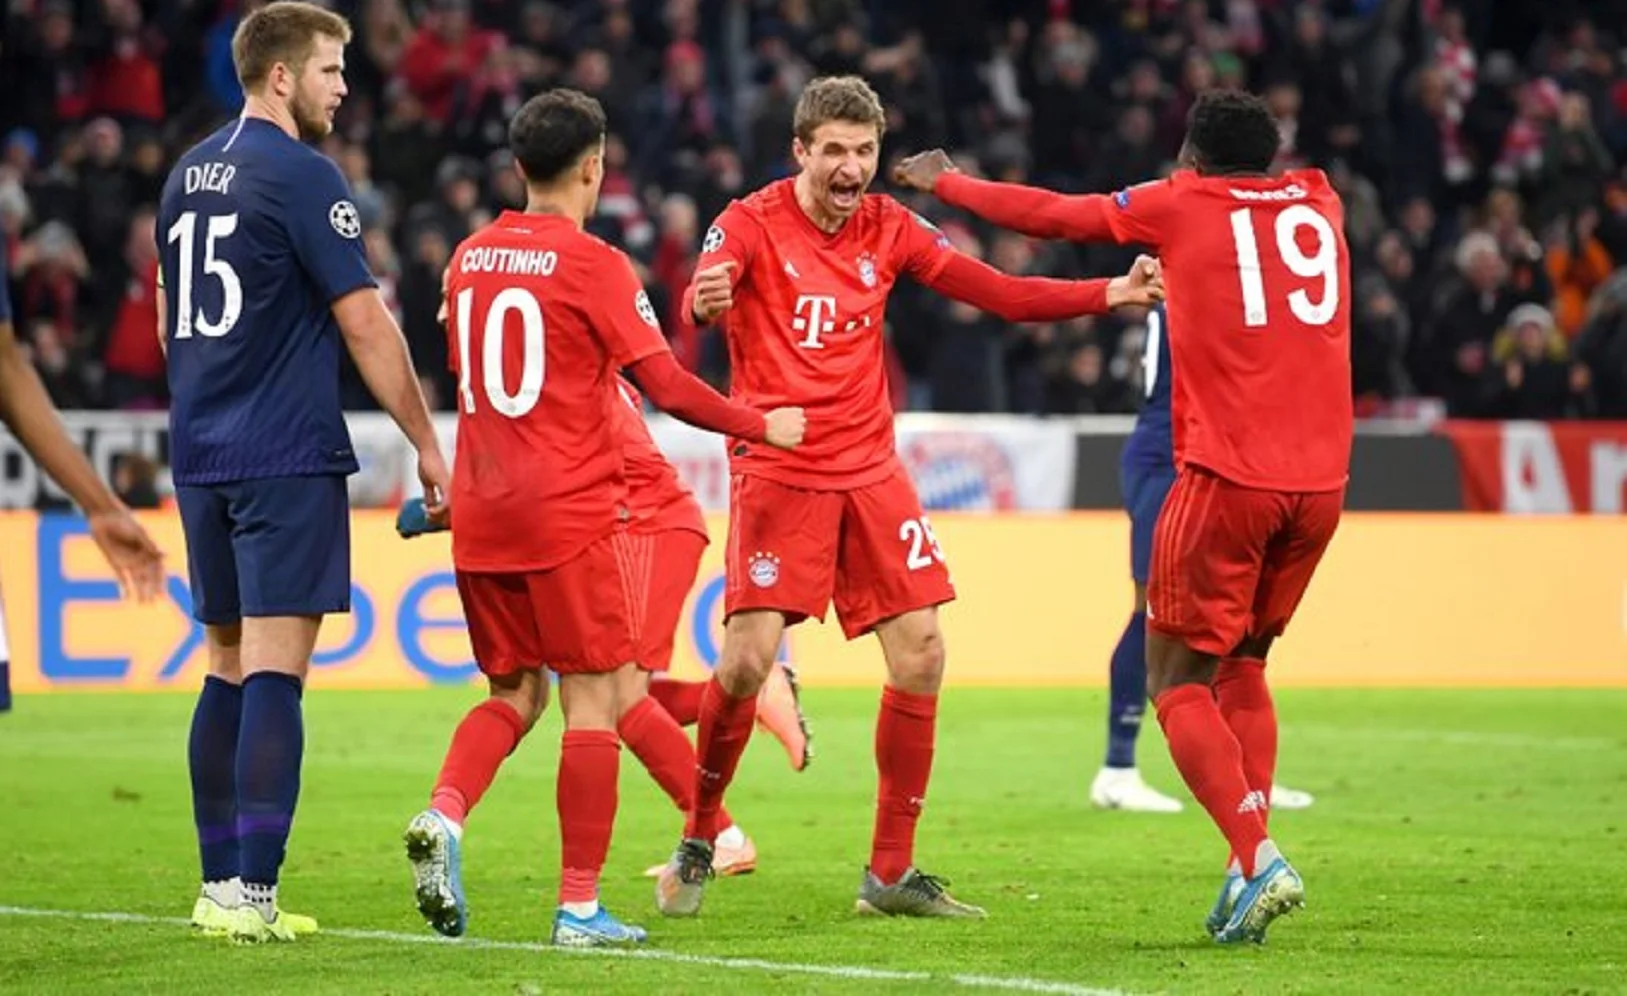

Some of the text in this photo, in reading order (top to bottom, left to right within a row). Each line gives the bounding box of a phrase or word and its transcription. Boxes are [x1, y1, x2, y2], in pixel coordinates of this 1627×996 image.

[185, 162, 236, 195] DIER
[167, 211, 242, 338] 15
[460, 247, 558, 276] COUTINHO
[1230, 204, 1339, 326] 19
[457, 287, 545, 419] 10
